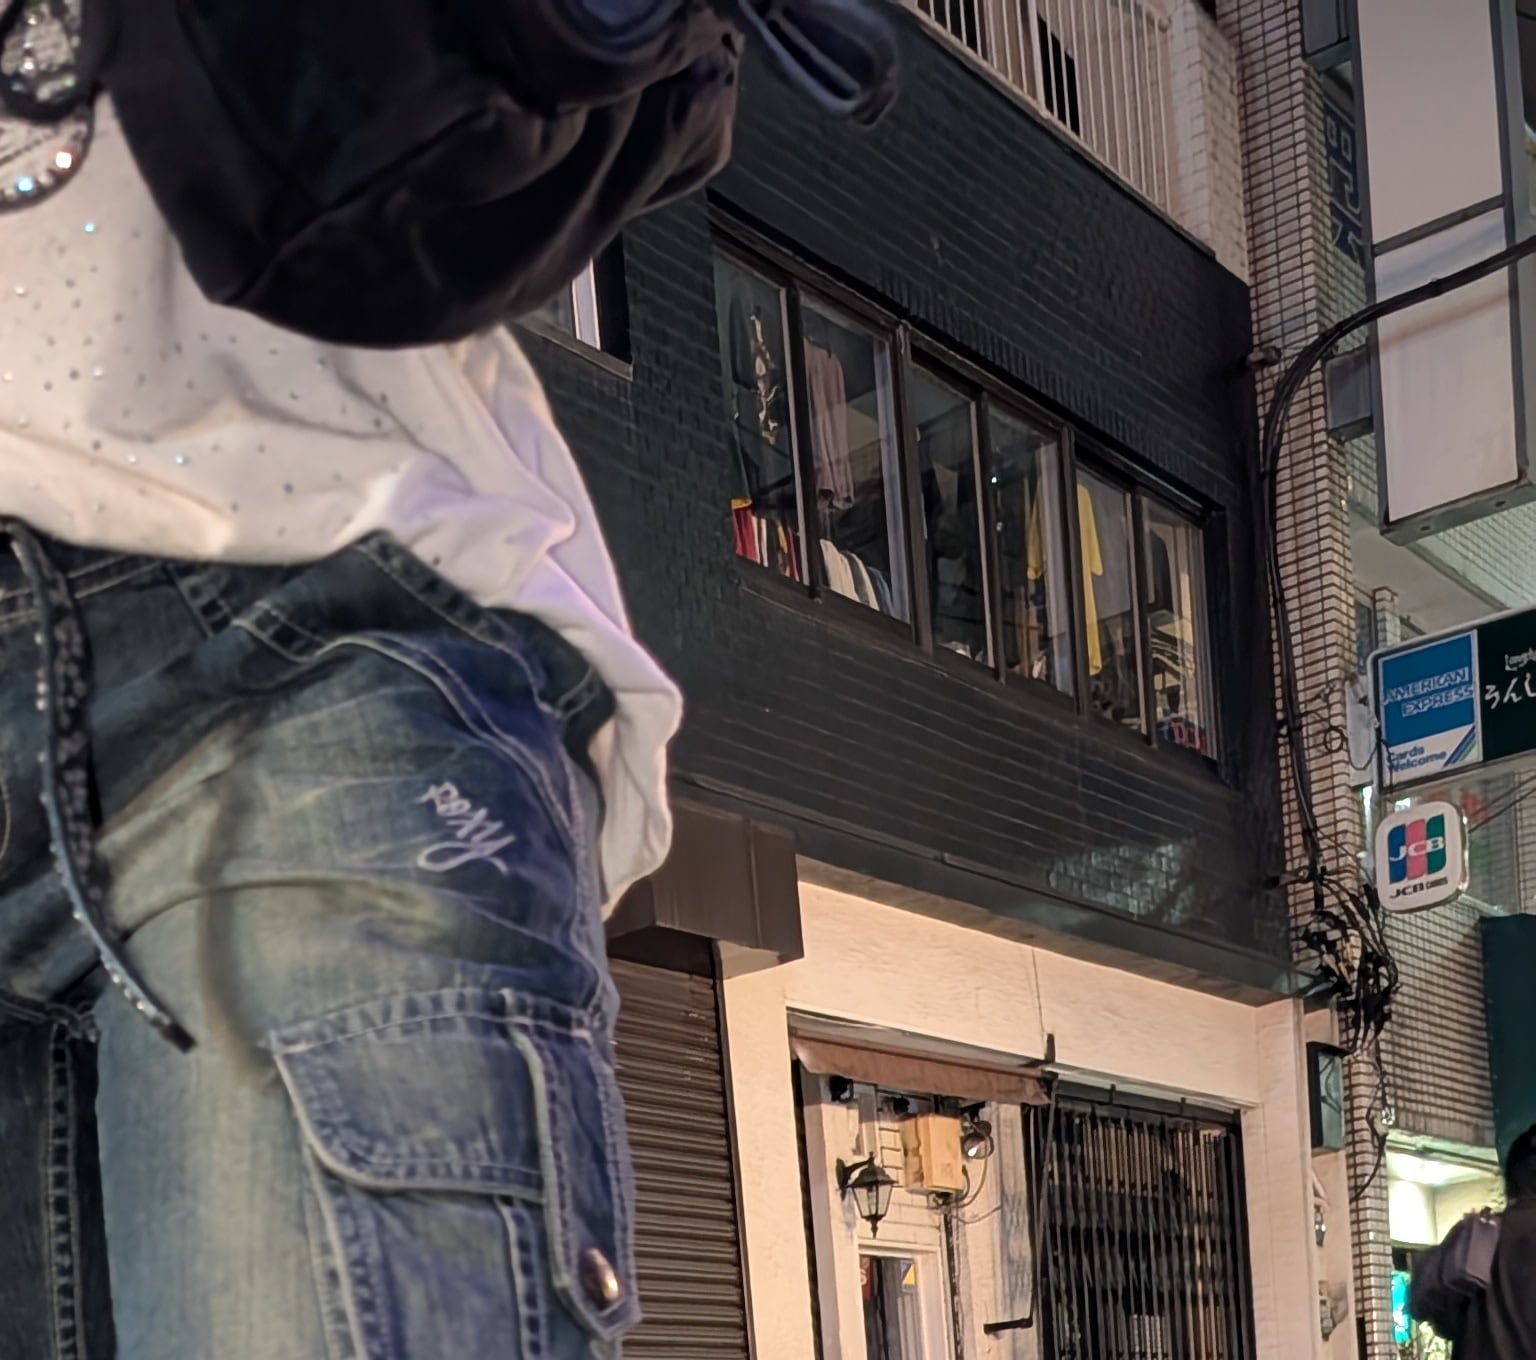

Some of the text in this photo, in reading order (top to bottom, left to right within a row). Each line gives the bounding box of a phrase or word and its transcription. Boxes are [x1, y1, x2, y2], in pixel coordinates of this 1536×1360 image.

[1383, 666, 1469, 705] AMERICAN
[1401, 686, 1475, 718] EXPRESS
[1387, 751, 1447, 772] Welcome
[1388, 744, 1425, 761] Cards
[1389, 836, 1446, 862] JCB
[1389, 882, 1424, 899] JCB
